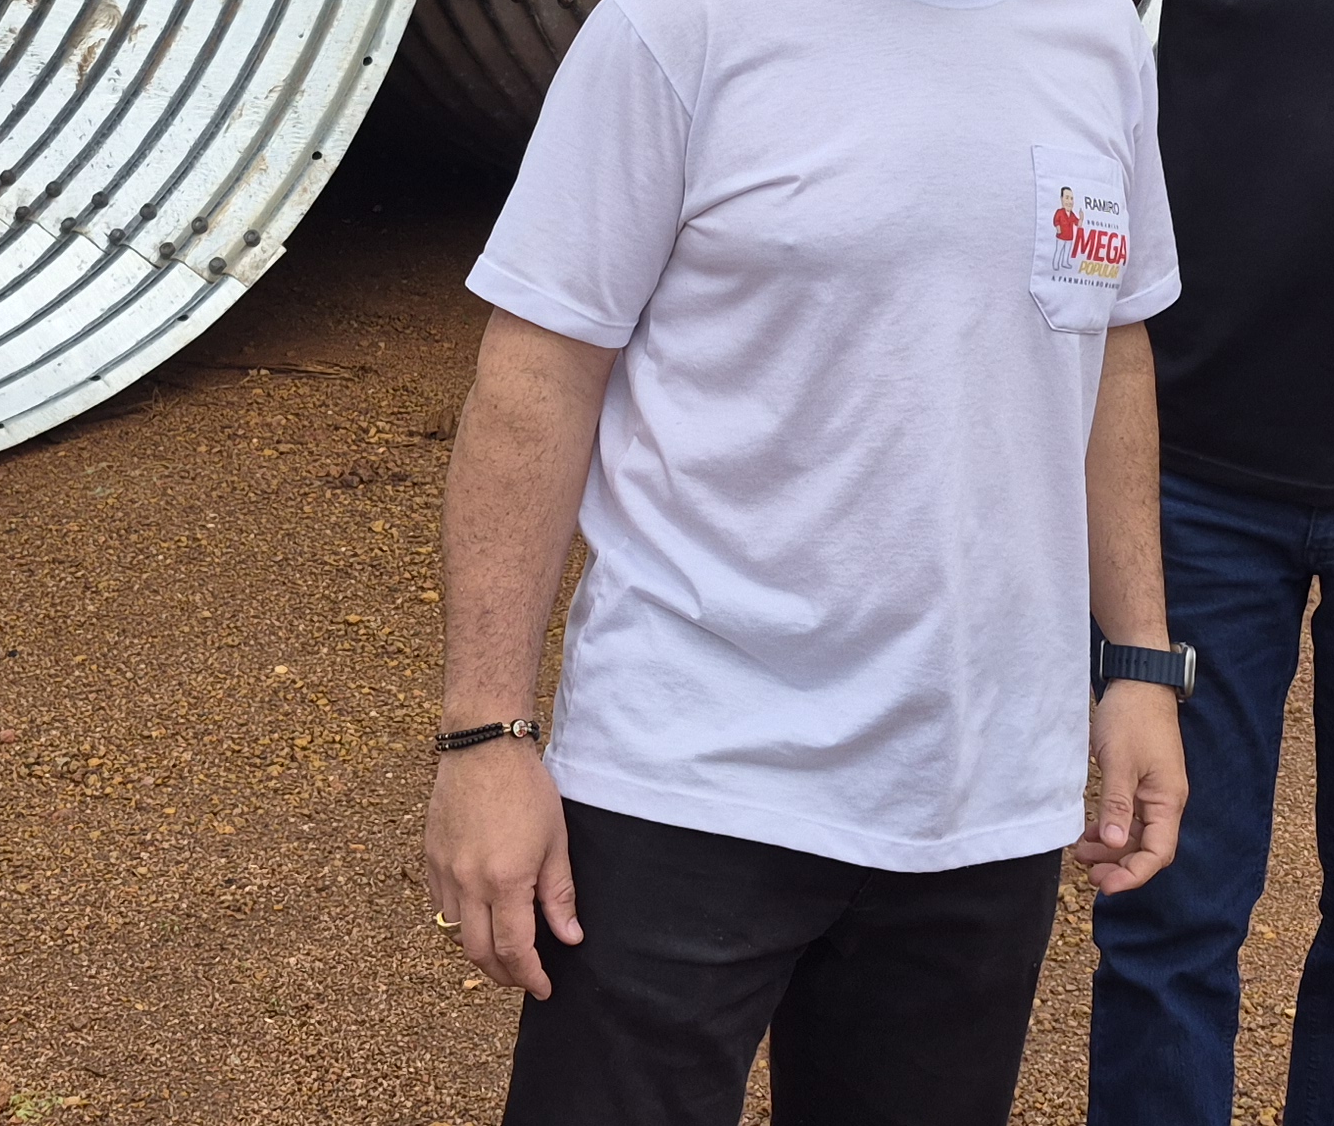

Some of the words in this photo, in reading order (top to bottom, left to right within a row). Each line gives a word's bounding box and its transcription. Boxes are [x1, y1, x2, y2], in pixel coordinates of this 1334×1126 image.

[1084, 196, 1120, 215] RAMIRO
[1071, 227, 1127, 266] MEGA
[1078, 260, 1120, 279] POPULAR
[1095, 280, 1104, 288] DO
